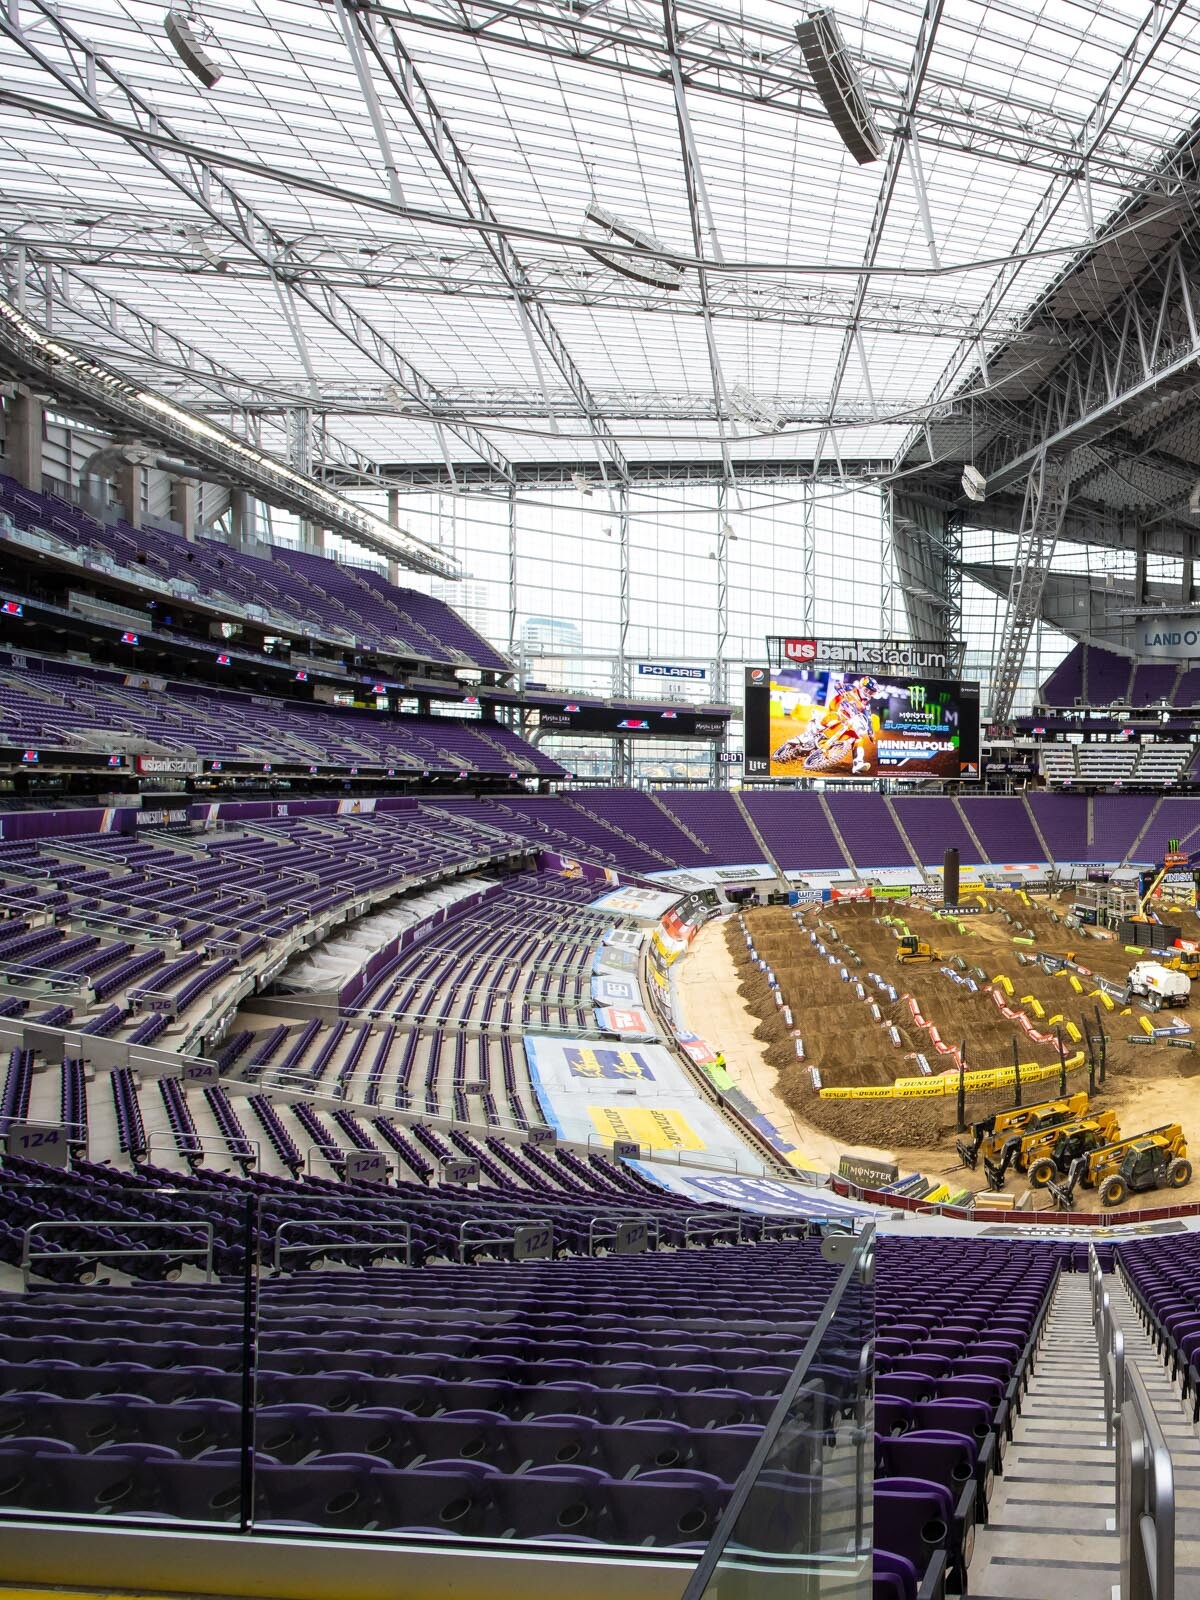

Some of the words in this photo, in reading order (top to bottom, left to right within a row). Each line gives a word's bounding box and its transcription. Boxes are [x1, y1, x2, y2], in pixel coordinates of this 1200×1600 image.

[1144, 633, 1181, 646] LAND
[642, 666, 703, 678] POLARIS
[877, 740, 955, 751] MINNEAPOLIS
[720, 753, 743, 763] 10:07
[748, 760, 768, 772] Lite
[136, 811, 163, 825] MINNESOTA
[168, 809, 187, 823] VIKINGS
[903, 1079, 943, 1087] DUNLOP
[903, 1088, 941, 1096] DUNLOP
[651, 1110, 682, 1143] DUNLOP
[20, 1130, 59, 1148] 124
[534, 1131, 552, 1142] 124
[621, 1144, 637, 1155] 124
[353, 1157, 381, 1173] 124
[453, 1165, 476, 1180] 124
[849, 1166, 892, 1182] MONSTER
[525, 1230, 549, 1252] 122
[626, 1226, 644, 1245] 122
